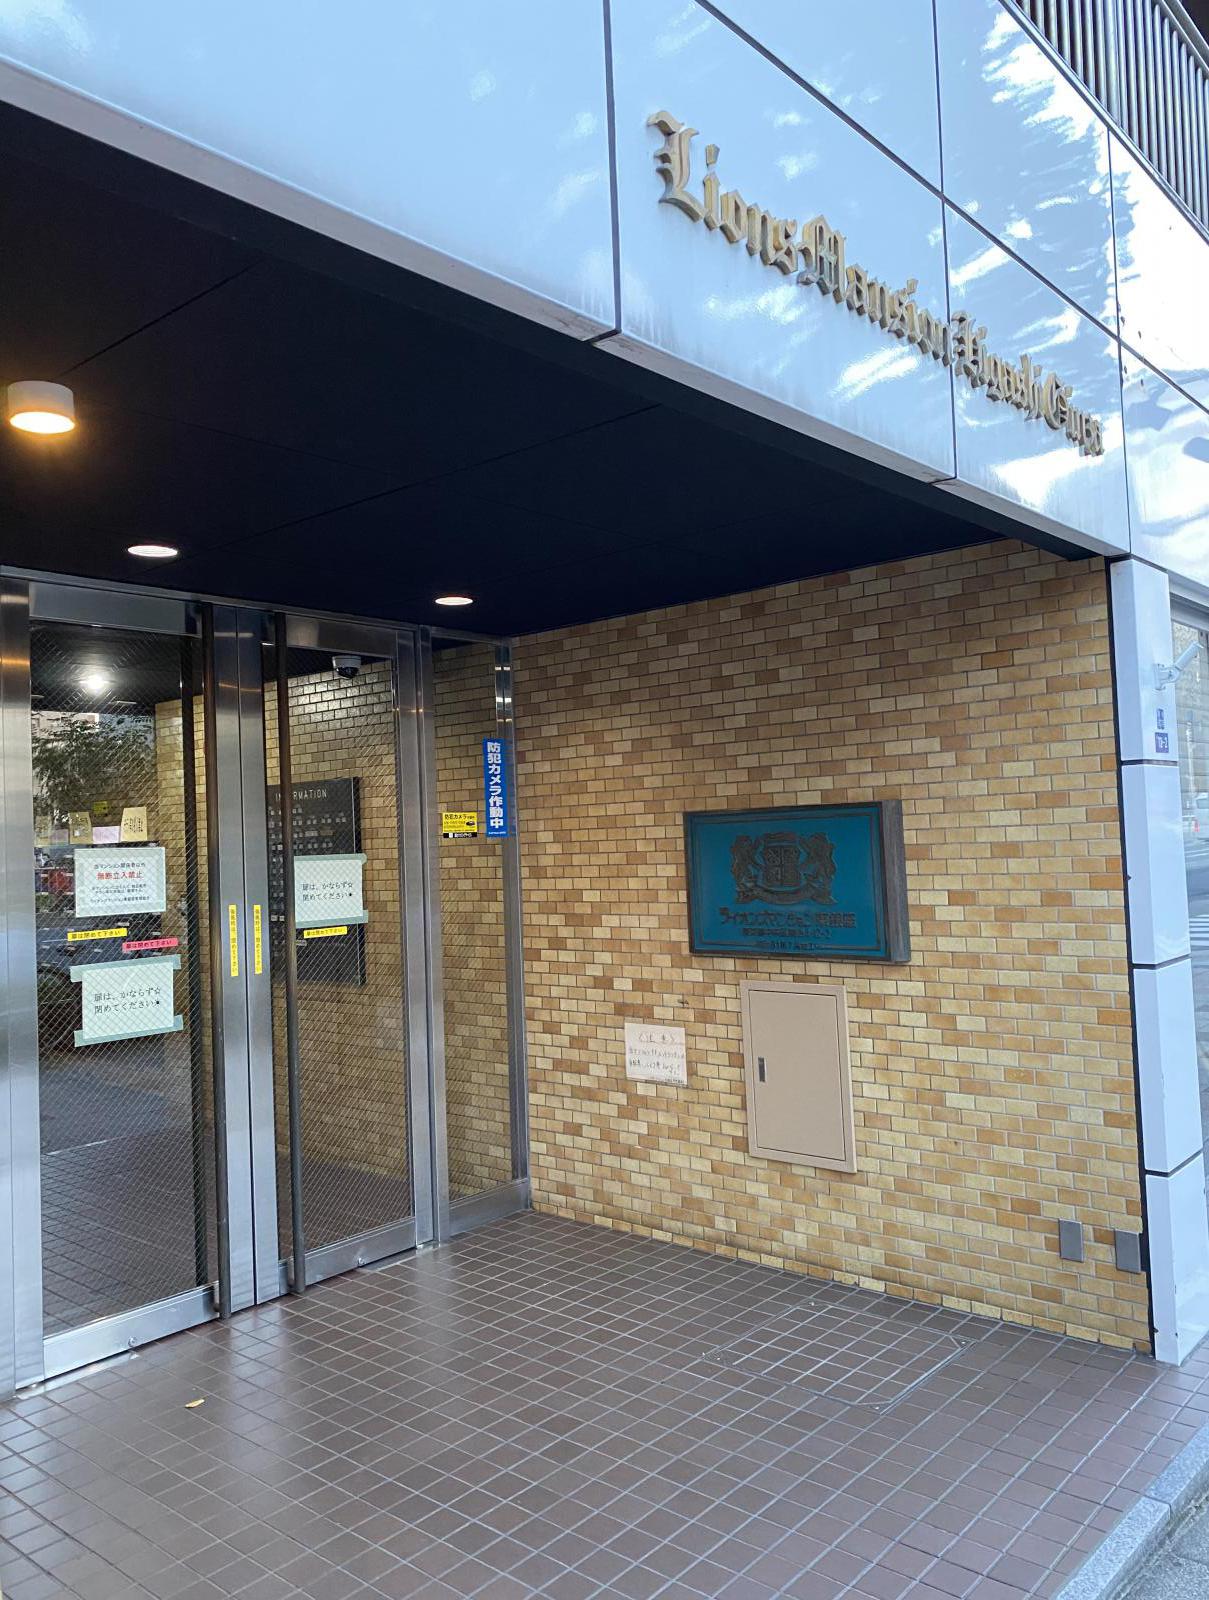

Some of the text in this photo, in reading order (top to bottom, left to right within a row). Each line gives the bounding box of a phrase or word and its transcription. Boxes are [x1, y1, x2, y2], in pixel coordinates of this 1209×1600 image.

[647, 110, 798, 275] Lions
[797, 214, 953, 367] Mansion
[487, 742, 504, 829] 防犯カメラ作動中
[275, 789, 327, 802] IRMATION
[96, 871, 143, 880] 無断立入禁止
[71, 930, 121, 940] 扉は閉めて下さい
